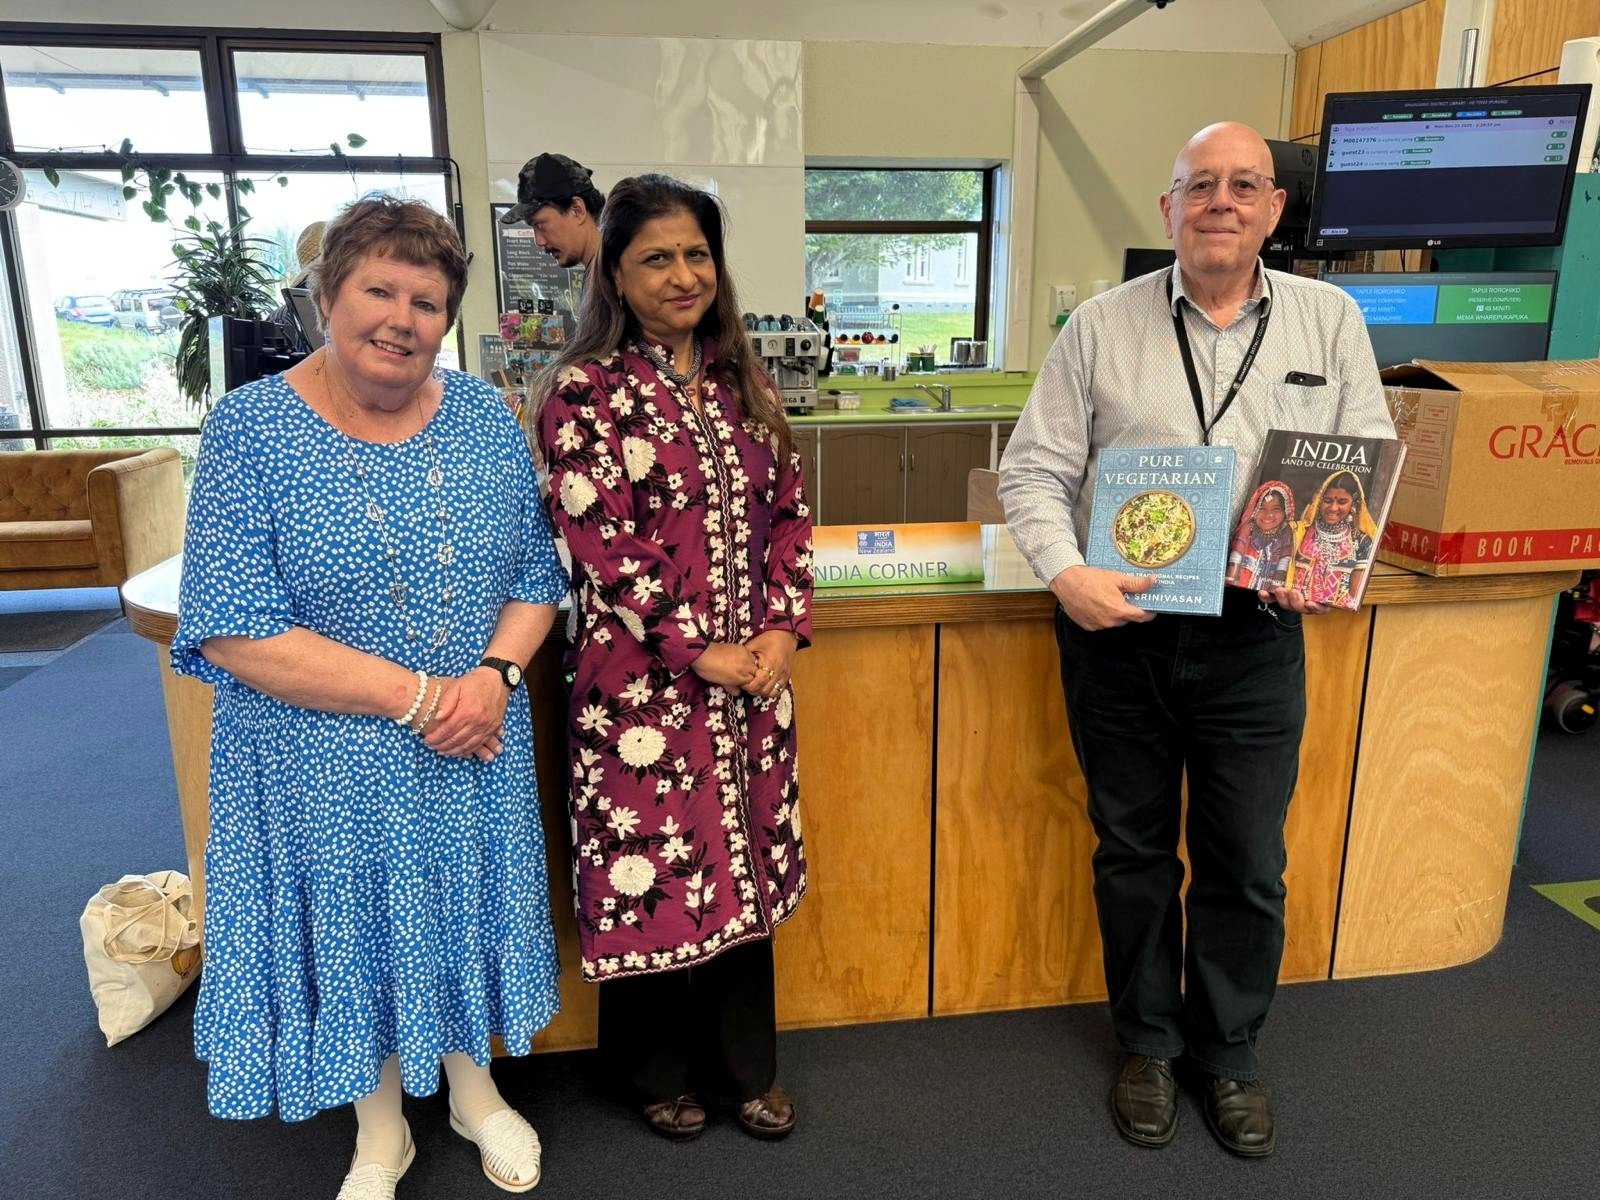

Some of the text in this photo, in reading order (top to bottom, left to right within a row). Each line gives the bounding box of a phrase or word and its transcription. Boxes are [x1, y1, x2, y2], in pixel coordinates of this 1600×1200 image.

[1291, 438, 1367, 465] INDIA
[1489, 423, 1600, 459] GRAC
[1138, 455, 1184, 468] PURE
[1281, 457, 1372, 474] LAND OF CELEBRATION
[1105, 472, 1217, 486] VEGETARIAN
[1400, 530, 1429, 555] PAC
[1477, 536, 1534, 557] BOOK
[1569, 534, 1600, 554] PA
[814, 561, 949, 582] NDIA CORNER
[1134, 593, 1202, 604] SRINIVASAN
